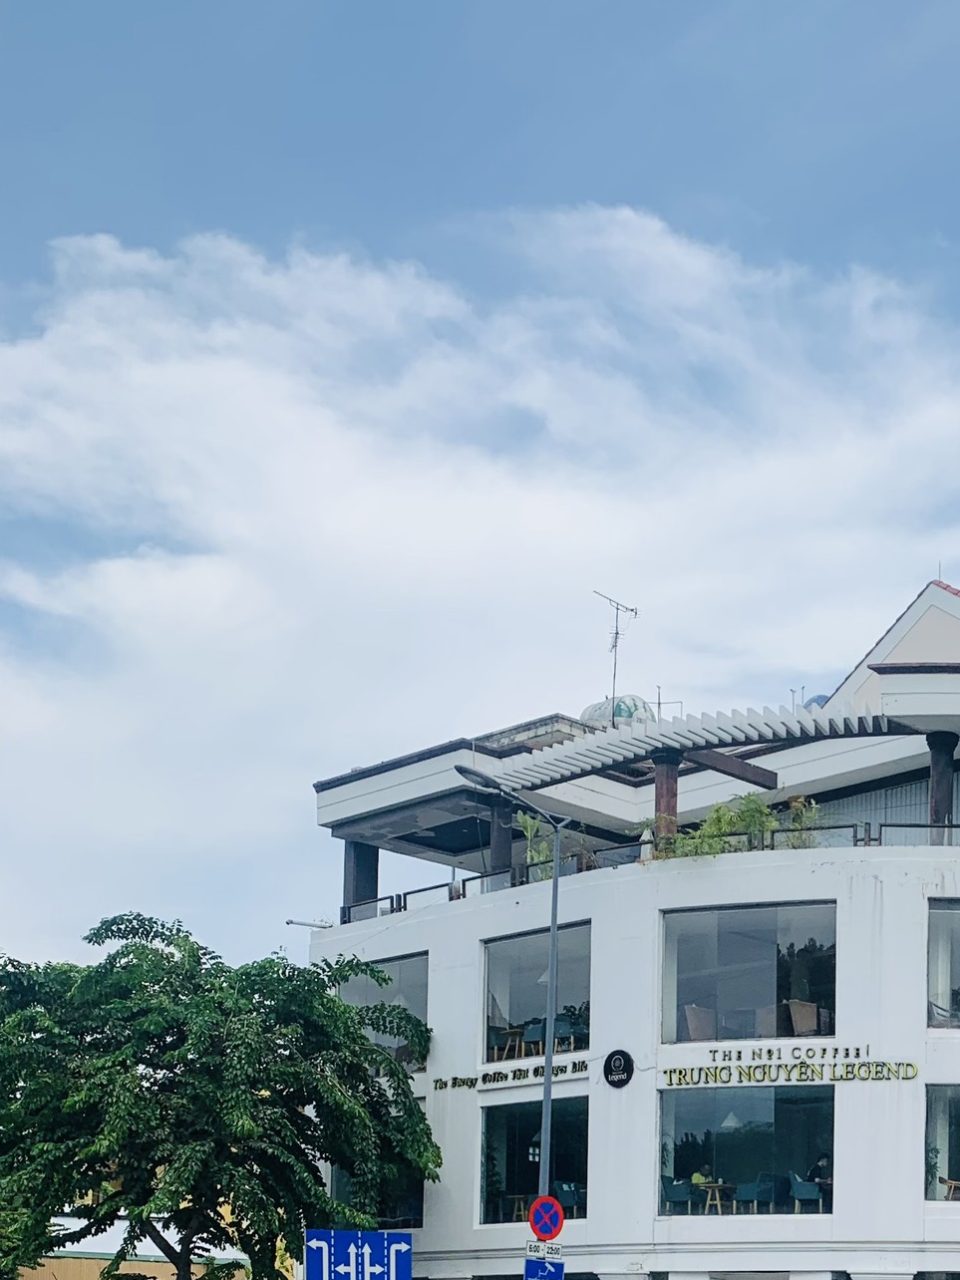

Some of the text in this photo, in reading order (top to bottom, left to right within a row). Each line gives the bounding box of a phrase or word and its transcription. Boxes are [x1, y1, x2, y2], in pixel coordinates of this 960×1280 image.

[709, 1049, 742, 1062] THE
[791, 1046, 861, 1060] COFFEE
[608, 1072, 627, 1082] Legend
[663, 1058, 918, 1085] TRUNG NGUYÊN LEGEND
